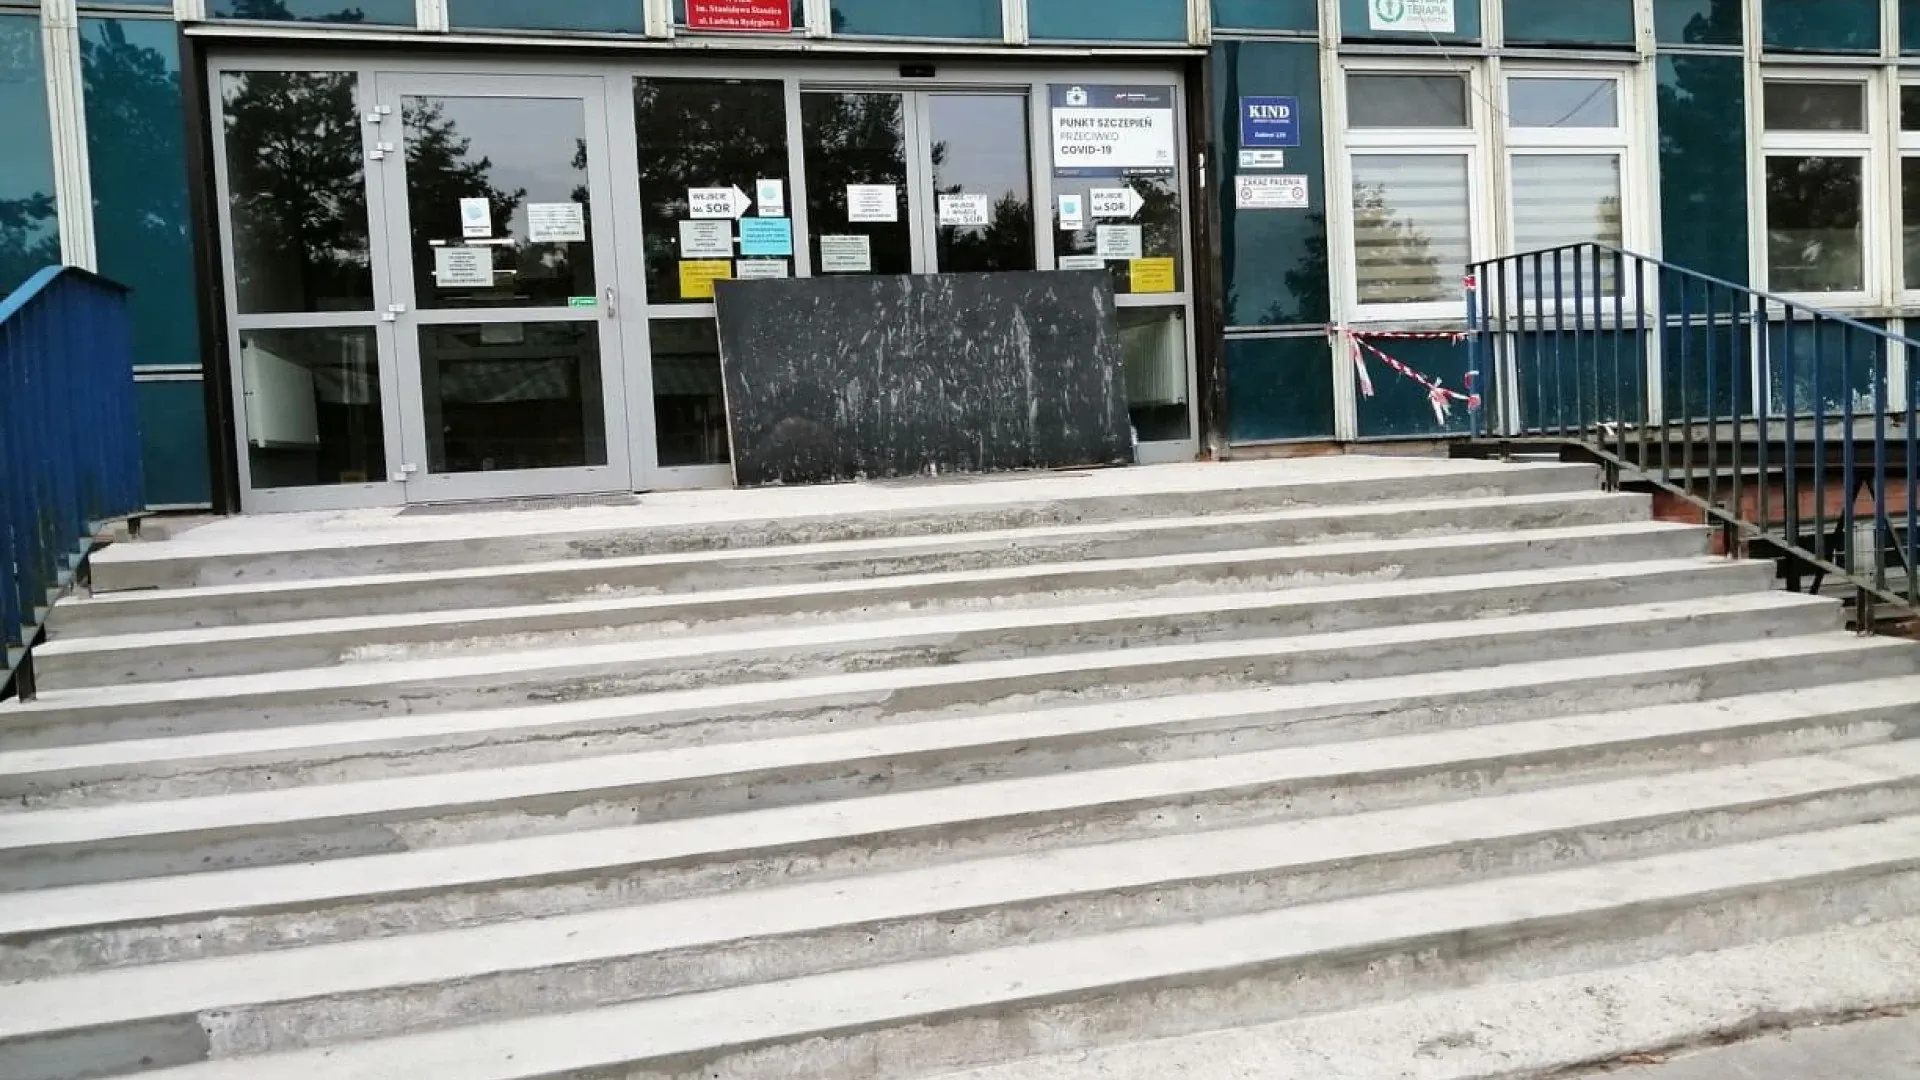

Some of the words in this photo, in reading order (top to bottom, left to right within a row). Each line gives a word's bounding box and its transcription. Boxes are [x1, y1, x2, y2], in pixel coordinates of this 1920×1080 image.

[1249, 105, 1290, 119] KIND
[1060, 118, 1095, 128] PUNKT
[1098, 115, 1152, 128] SZCZEPIEŃ
[1060, 132, 1119, 141] PRZECIWKO
[1061, 145, 1112, 155] COVID-19
[705, 203, 731, 213] SOR
[1103, 202, 1126, 211] SOR
